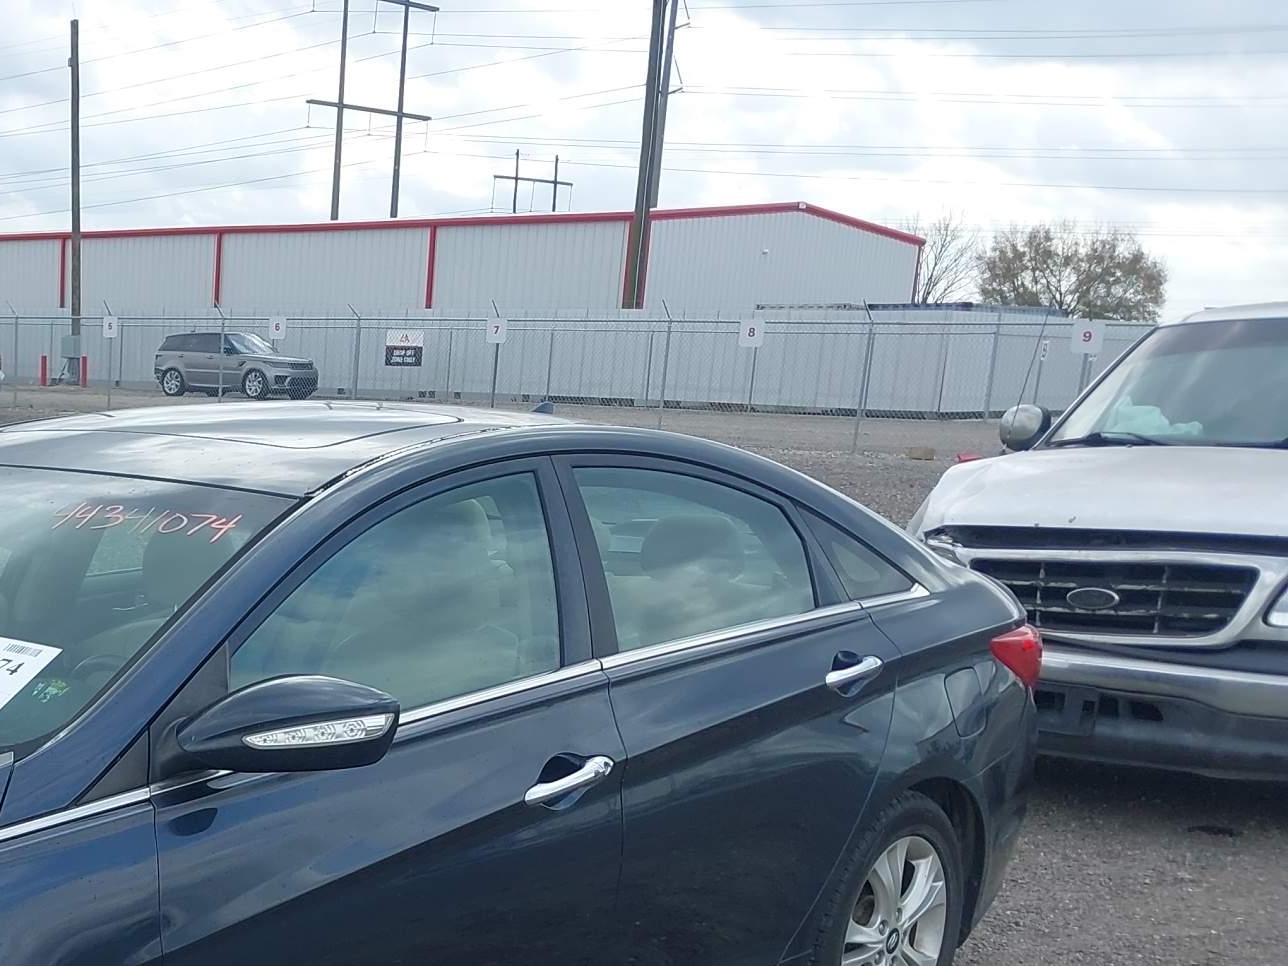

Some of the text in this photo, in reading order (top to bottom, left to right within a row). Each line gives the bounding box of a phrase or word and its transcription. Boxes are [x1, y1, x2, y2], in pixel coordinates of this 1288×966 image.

[274, 322, 281, 332] 6
[493, 325, 500, 335] 7
[747, 327, 756, 338] 8
[1082, 330, 1093, 343] 9
[50, 501, 243, 545] 44341074
